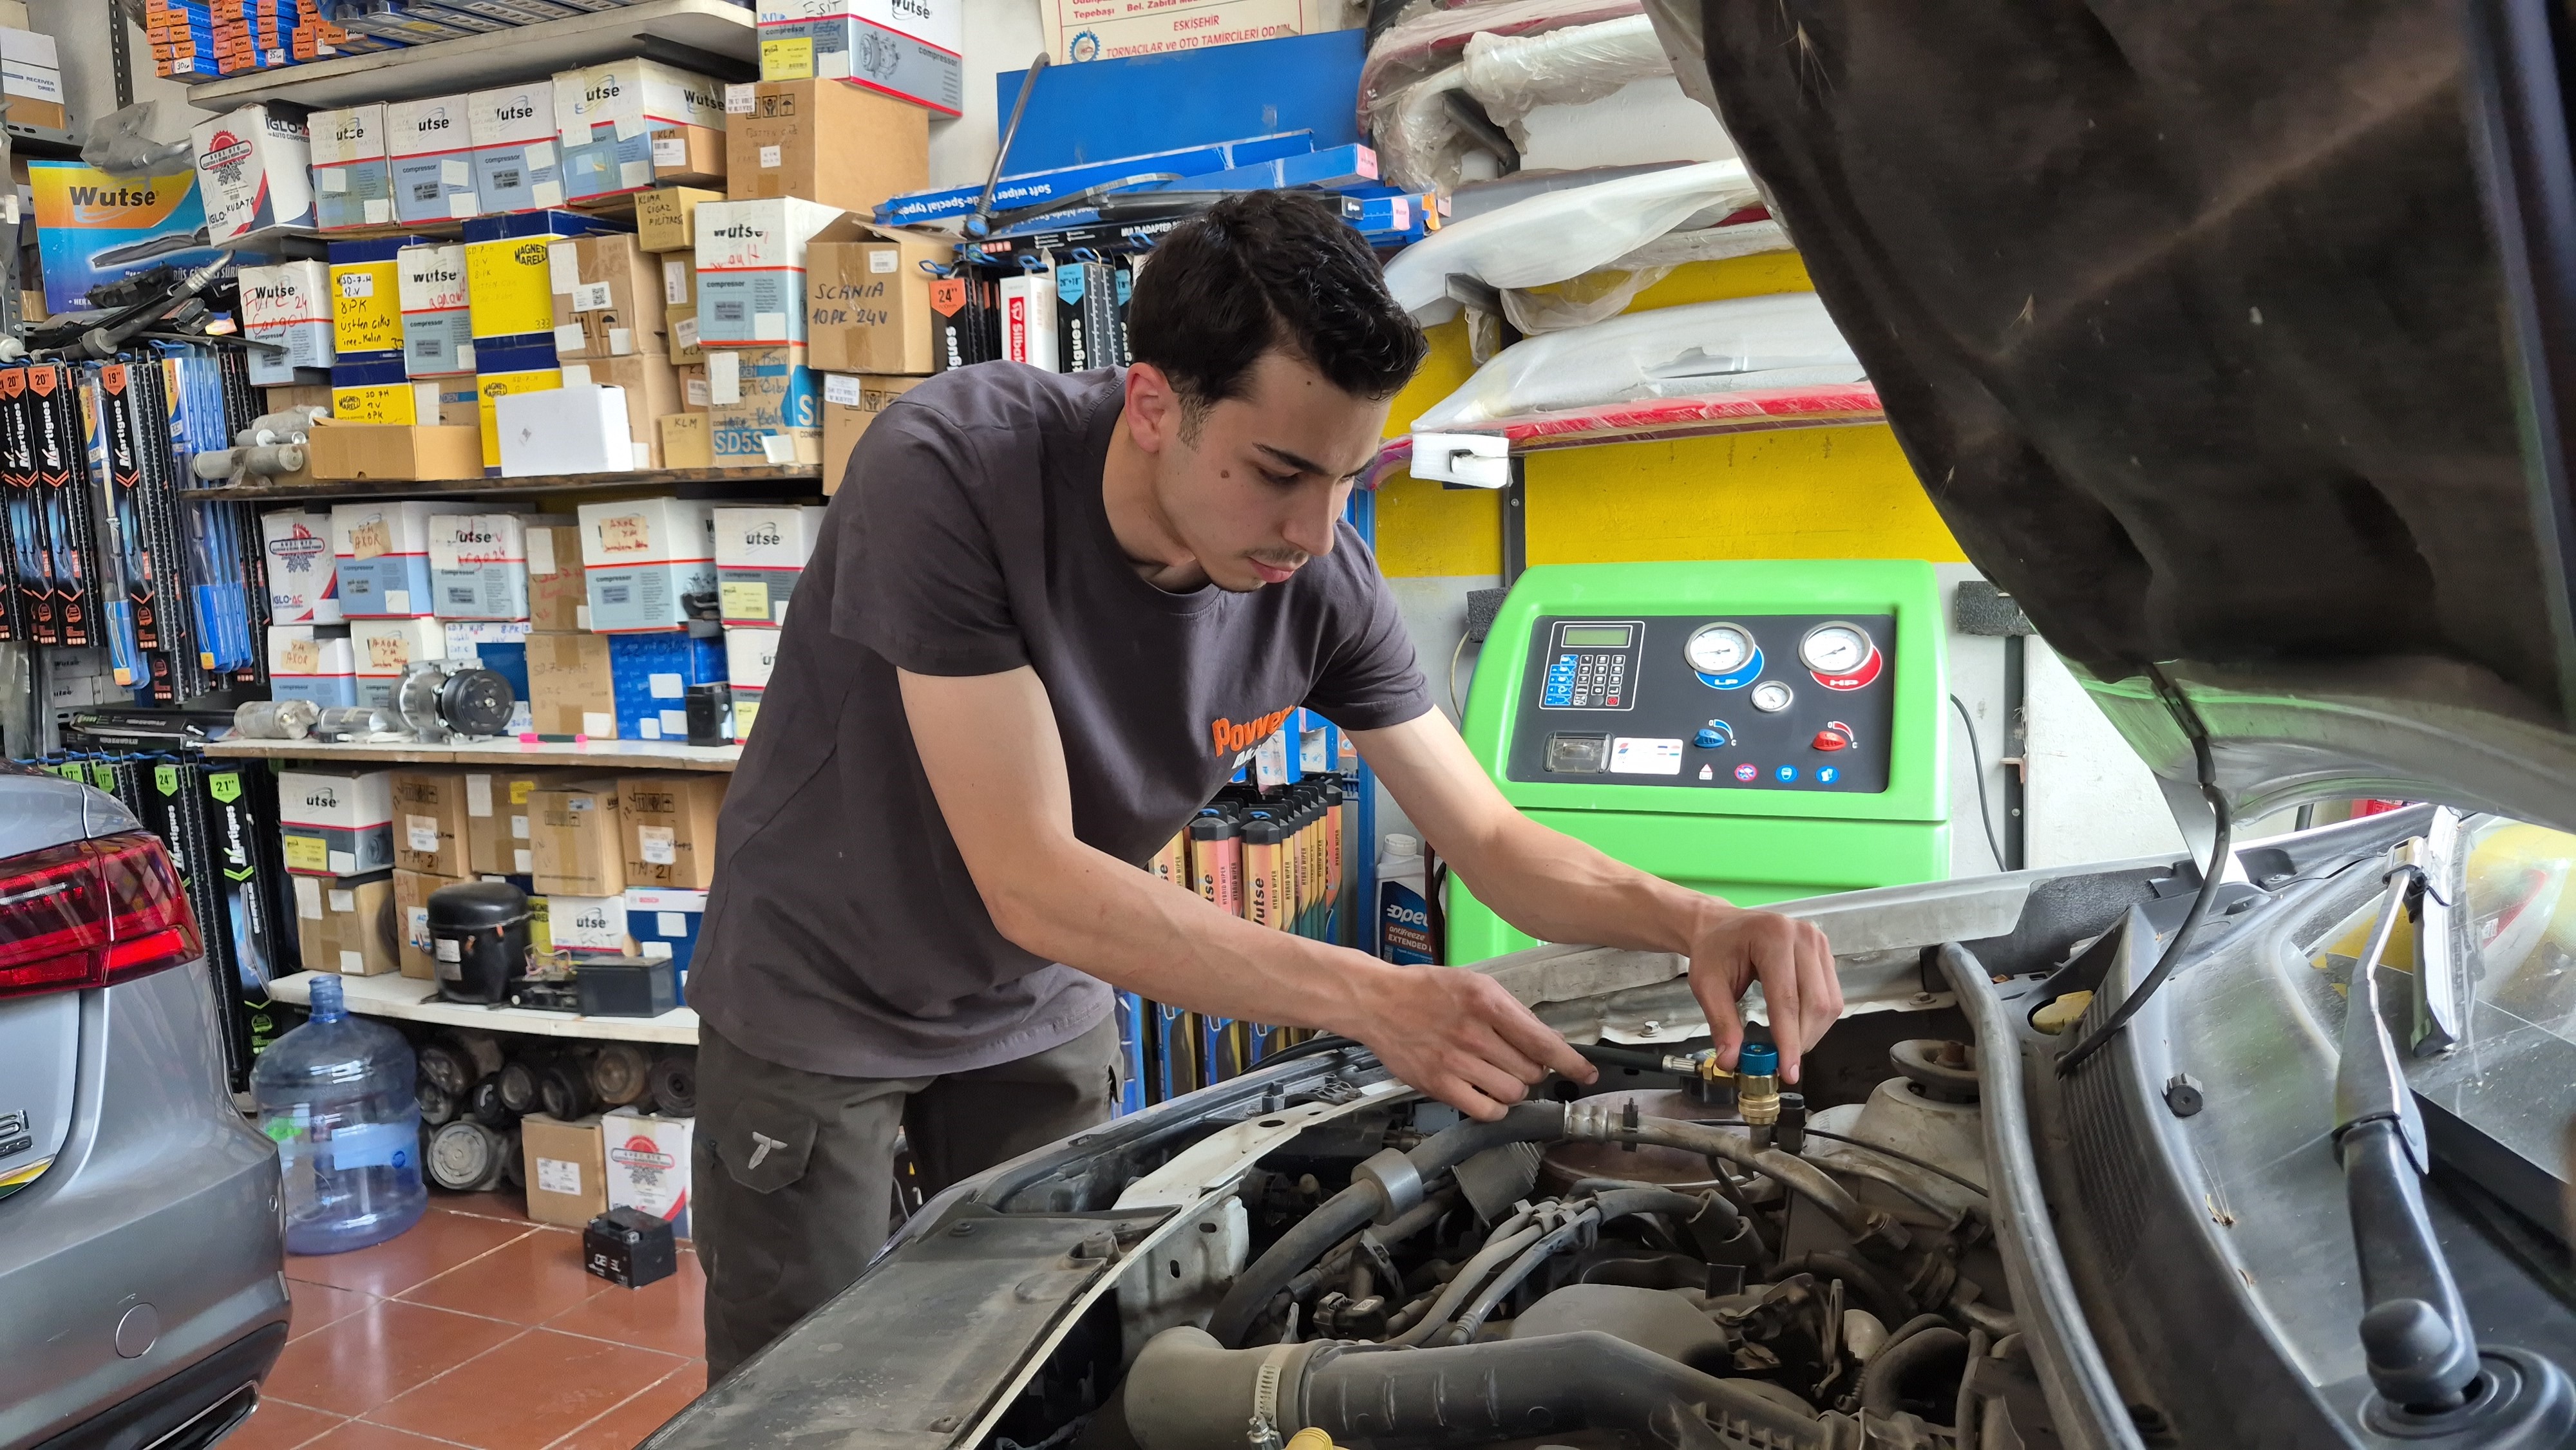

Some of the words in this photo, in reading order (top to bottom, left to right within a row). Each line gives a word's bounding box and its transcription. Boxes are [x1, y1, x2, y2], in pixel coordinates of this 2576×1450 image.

[1173, 15, 1220, 32] ESKİŞEHİR
[1106, 43, 1163, 59] TORNACILAR
[1180, 37, 1198, 49] OTO
[1202, 26, 1260, 46] TAMİRCİLERİ
[918, 45, 958, 66] compressor
[26, 76, 54, 86] RECEIVER
[585, 84, 621, 102] utse
[684, 88, 725, 110] Wutse
[495, 106, 533, 121] utse
[419, 117, 450, 132] utse
[485, 154, 520, 164] compressor
[402, 164, 437, 173] compressor
[69, 186, 156, 207] Wutse
[1030, 184, 1052, 196] Soft
[256, 285, 296, 299] Wutse
[814, 283, 885, 301] SCANIA
[939, 288, 958, 303] 24"
[410, 319, 443, 328] compressor
[8, 375, 19, 388] 20"
[35, 373, 50, 386] 20"
[108, 372, 120, 384] 19"
[14, 402, 31, 471] Martigues
[42, 400, 61, 471] Martigues
[113, 399, 132, 470] Martigues
[456, 530, 491, 543] utse
[746, 532, 781, 546] utse
[596, 574, 632, 583] compressor
[159, 775, 173, 785] 24"
[216, 780, 235, 792] 21"
[307, 795, 337, 808] utse
[223, 805, 247, 867] Martigues
[1204, 873, 1216, 903] tse
[576, 916, 606, 928] utse
[1389, 926, 1425, 941] antifreeze
[1388, 934, 1428, 950] EXTENDED
